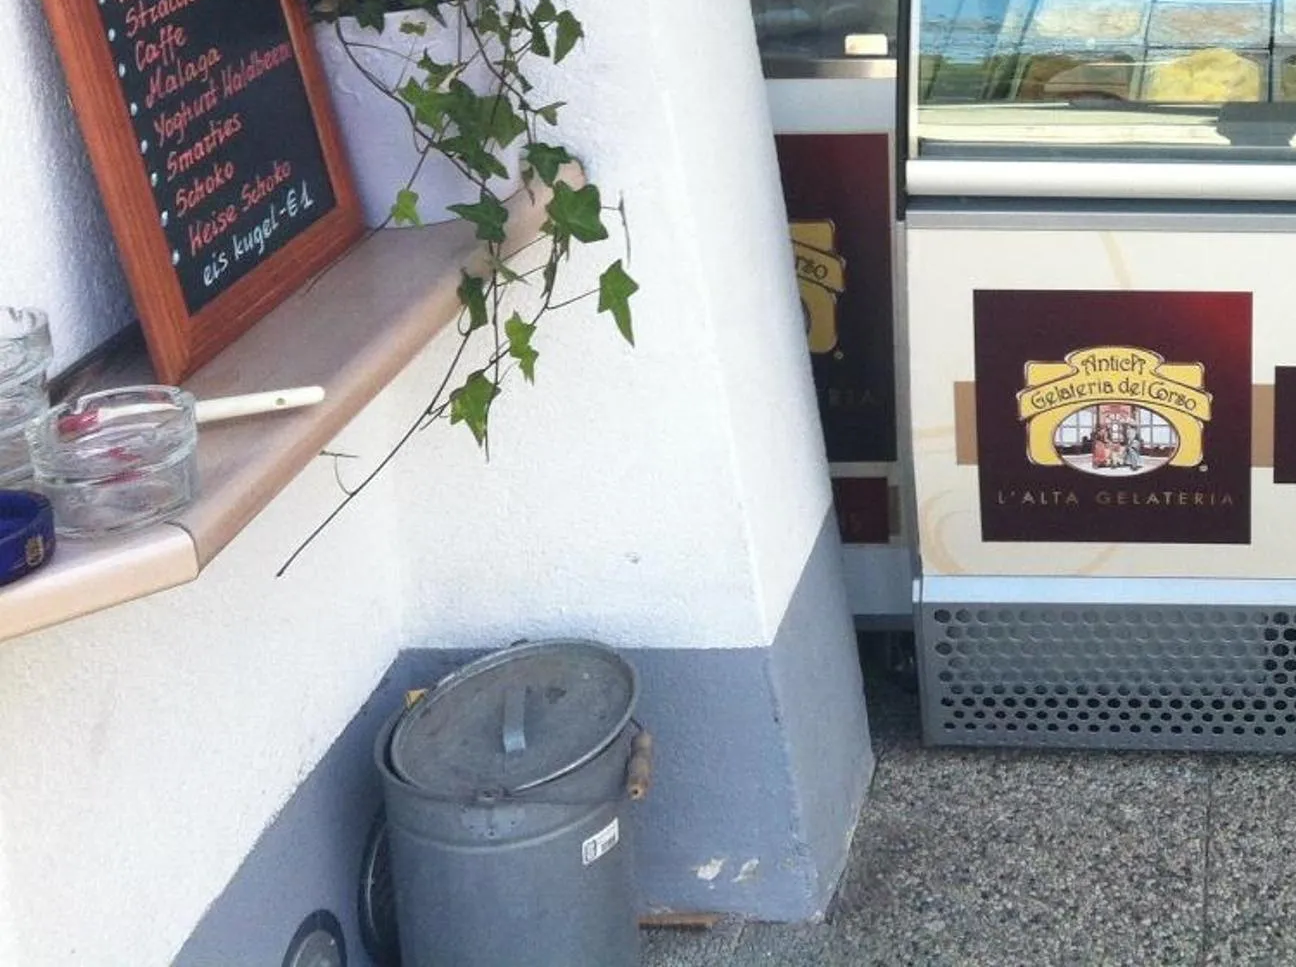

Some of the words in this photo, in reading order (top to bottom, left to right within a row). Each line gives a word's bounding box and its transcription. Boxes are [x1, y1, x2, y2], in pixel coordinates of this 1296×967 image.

[146, 45, 223, 109] Malaga
[167, 112, 243, 182] Smarties
[176, 160, 237, 218] Schoko
[188, 203, 240, 257] Heise
[240, 159, 293, 213] Schoko
[1030, 378, 1115, 411] Gelateria
[1117, 377, 1145, 398] del
[1146, 381, 1198, 412] Corso
[997, 490, 1080, 506] L'ALTA
[1095, 490, 1235, 506] GELATERIA
